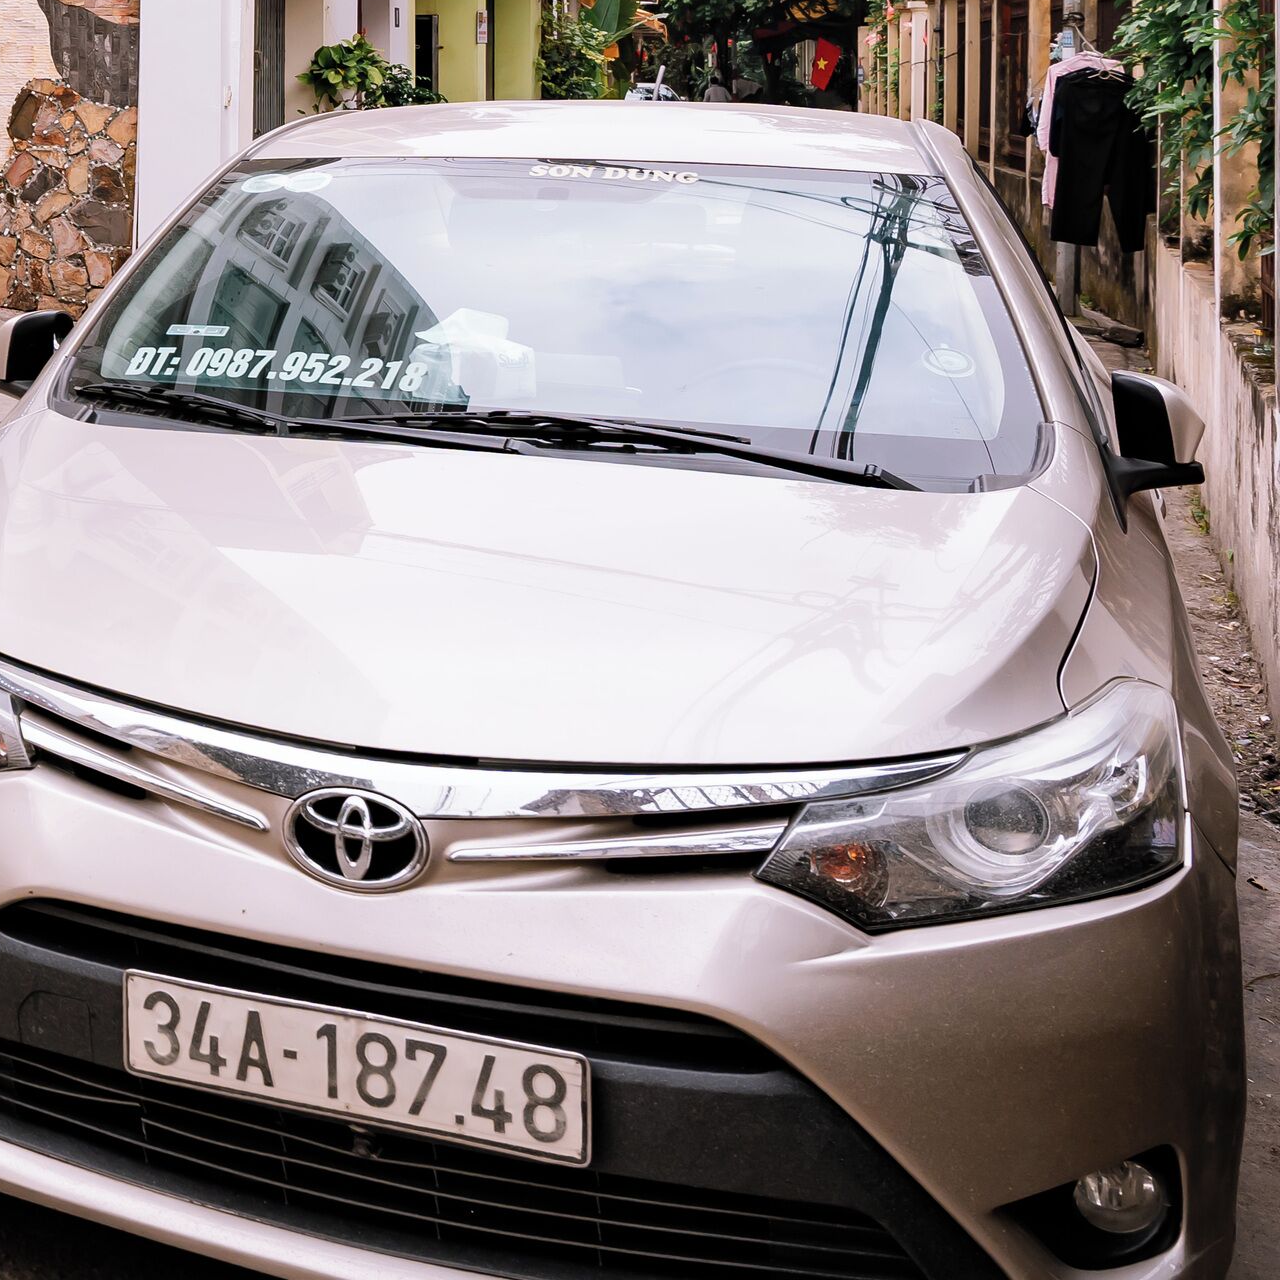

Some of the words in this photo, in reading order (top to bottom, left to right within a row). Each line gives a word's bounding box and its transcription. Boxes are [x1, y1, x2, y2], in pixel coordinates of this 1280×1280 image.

[125, 347, 181, 376] ĐT:
[184, 348, 428, 392] 0987.952.218
[142, 990, 567, 1143] 34A-187.48
